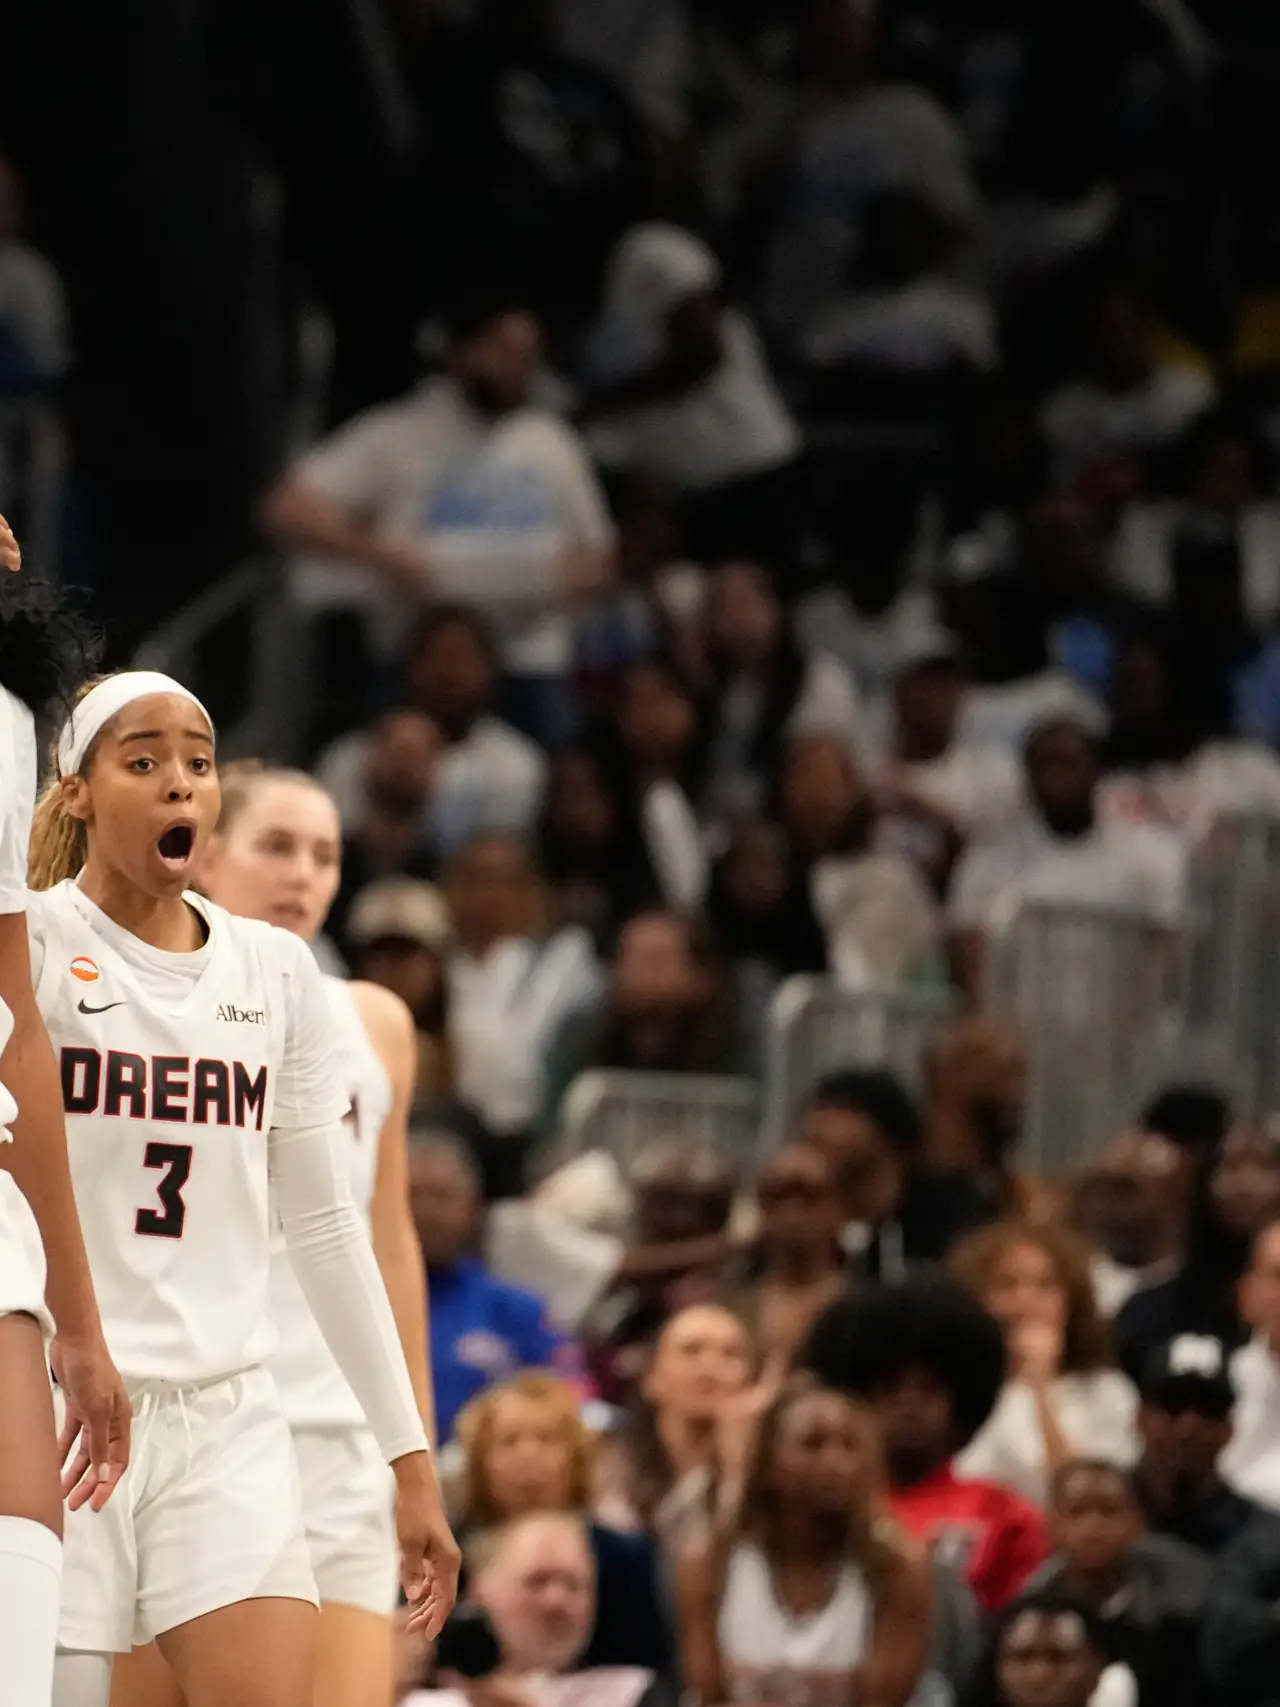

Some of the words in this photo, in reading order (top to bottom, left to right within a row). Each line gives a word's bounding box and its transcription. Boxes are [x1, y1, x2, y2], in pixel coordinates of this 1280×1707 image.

[216, 1003, 266, 1026] Albert
[60, 1046, 268, 1132] DREAM
[134, 1142, 193, 1239] 3
